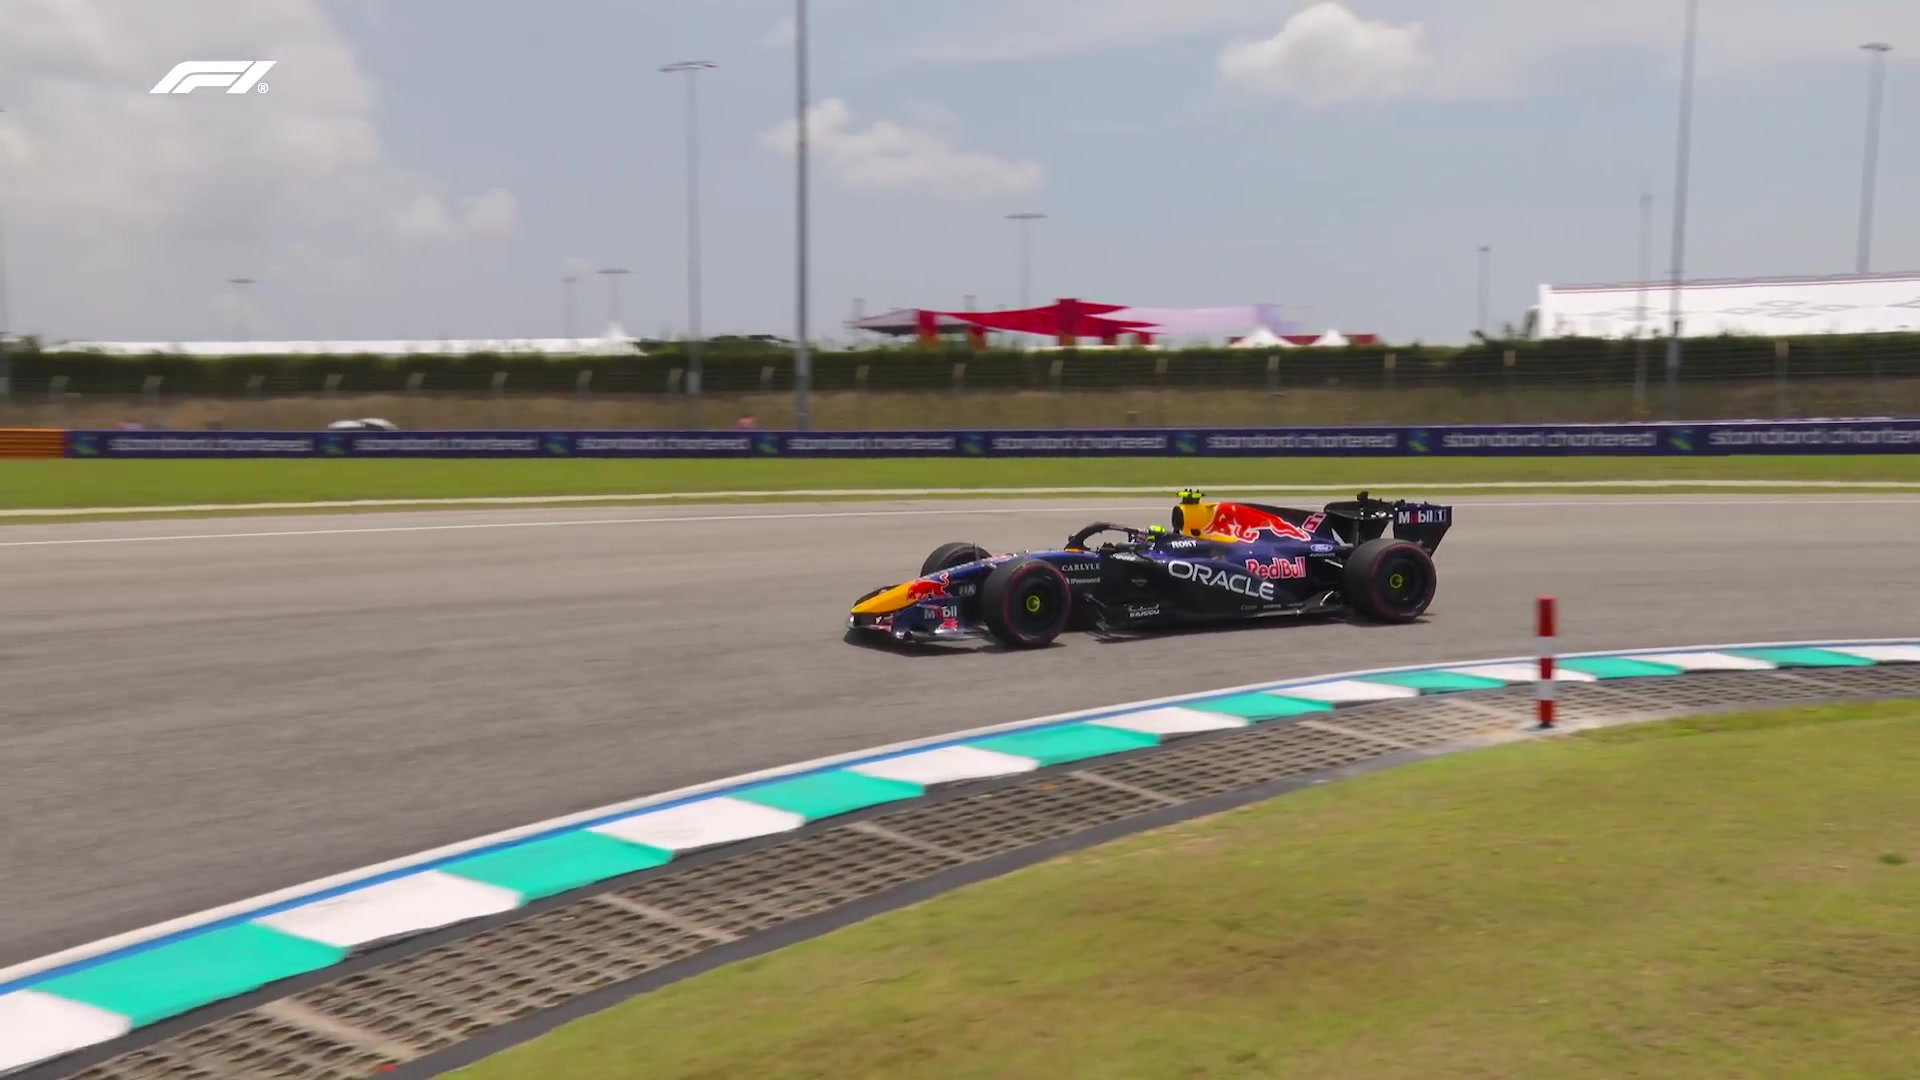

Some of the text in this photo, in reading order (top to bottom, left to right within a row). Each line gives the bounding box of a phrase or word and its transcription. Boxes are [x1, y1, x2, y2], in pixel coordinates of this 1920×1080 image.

[1398, 510, 1433, 525] Mobil
[1061, 563, 1101, 572] CARLYLE
[1168, 560, 1274, 601] ORACLE
[924, 605, 958, 620] Mobil
